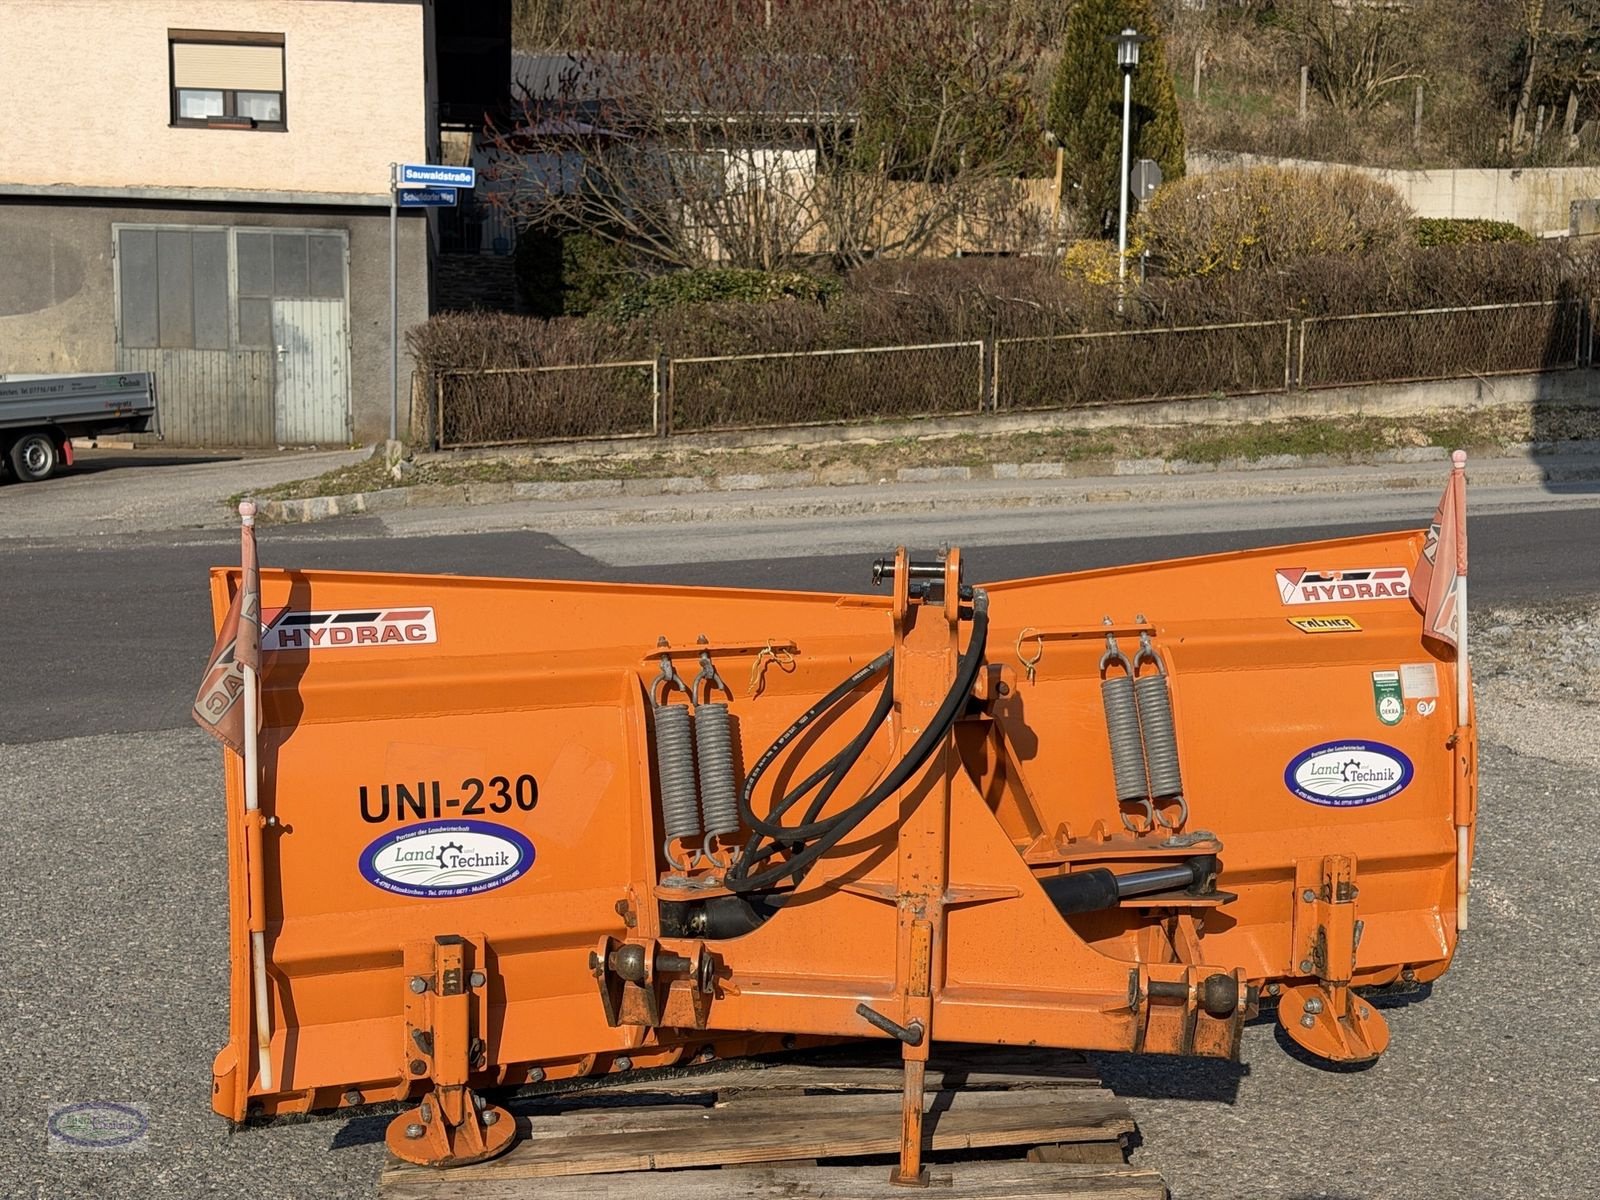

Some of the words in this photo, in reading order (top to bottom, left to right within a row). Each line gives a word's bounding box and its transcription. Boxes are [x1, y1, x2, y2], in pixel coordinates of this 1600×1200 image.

[406, 169, 471, 182] Sauwaldstraße
[440, 193, 454, 203] Weg
[1301, 581, 1408, 602] HYDRAC
[278, 623, 428, 648] HYDRAC
[1310, 761, 1340, 776] Land
[1350, 768, 1395, 782] Technik
[359, 774, 539, 824] UNI-230
[395, 831, 417, 842] Partner
[427, 826, 470, 834] Landwirtschaft
[394, 845, 436, 862] Land
[449, 851, 510, 869] Technik
